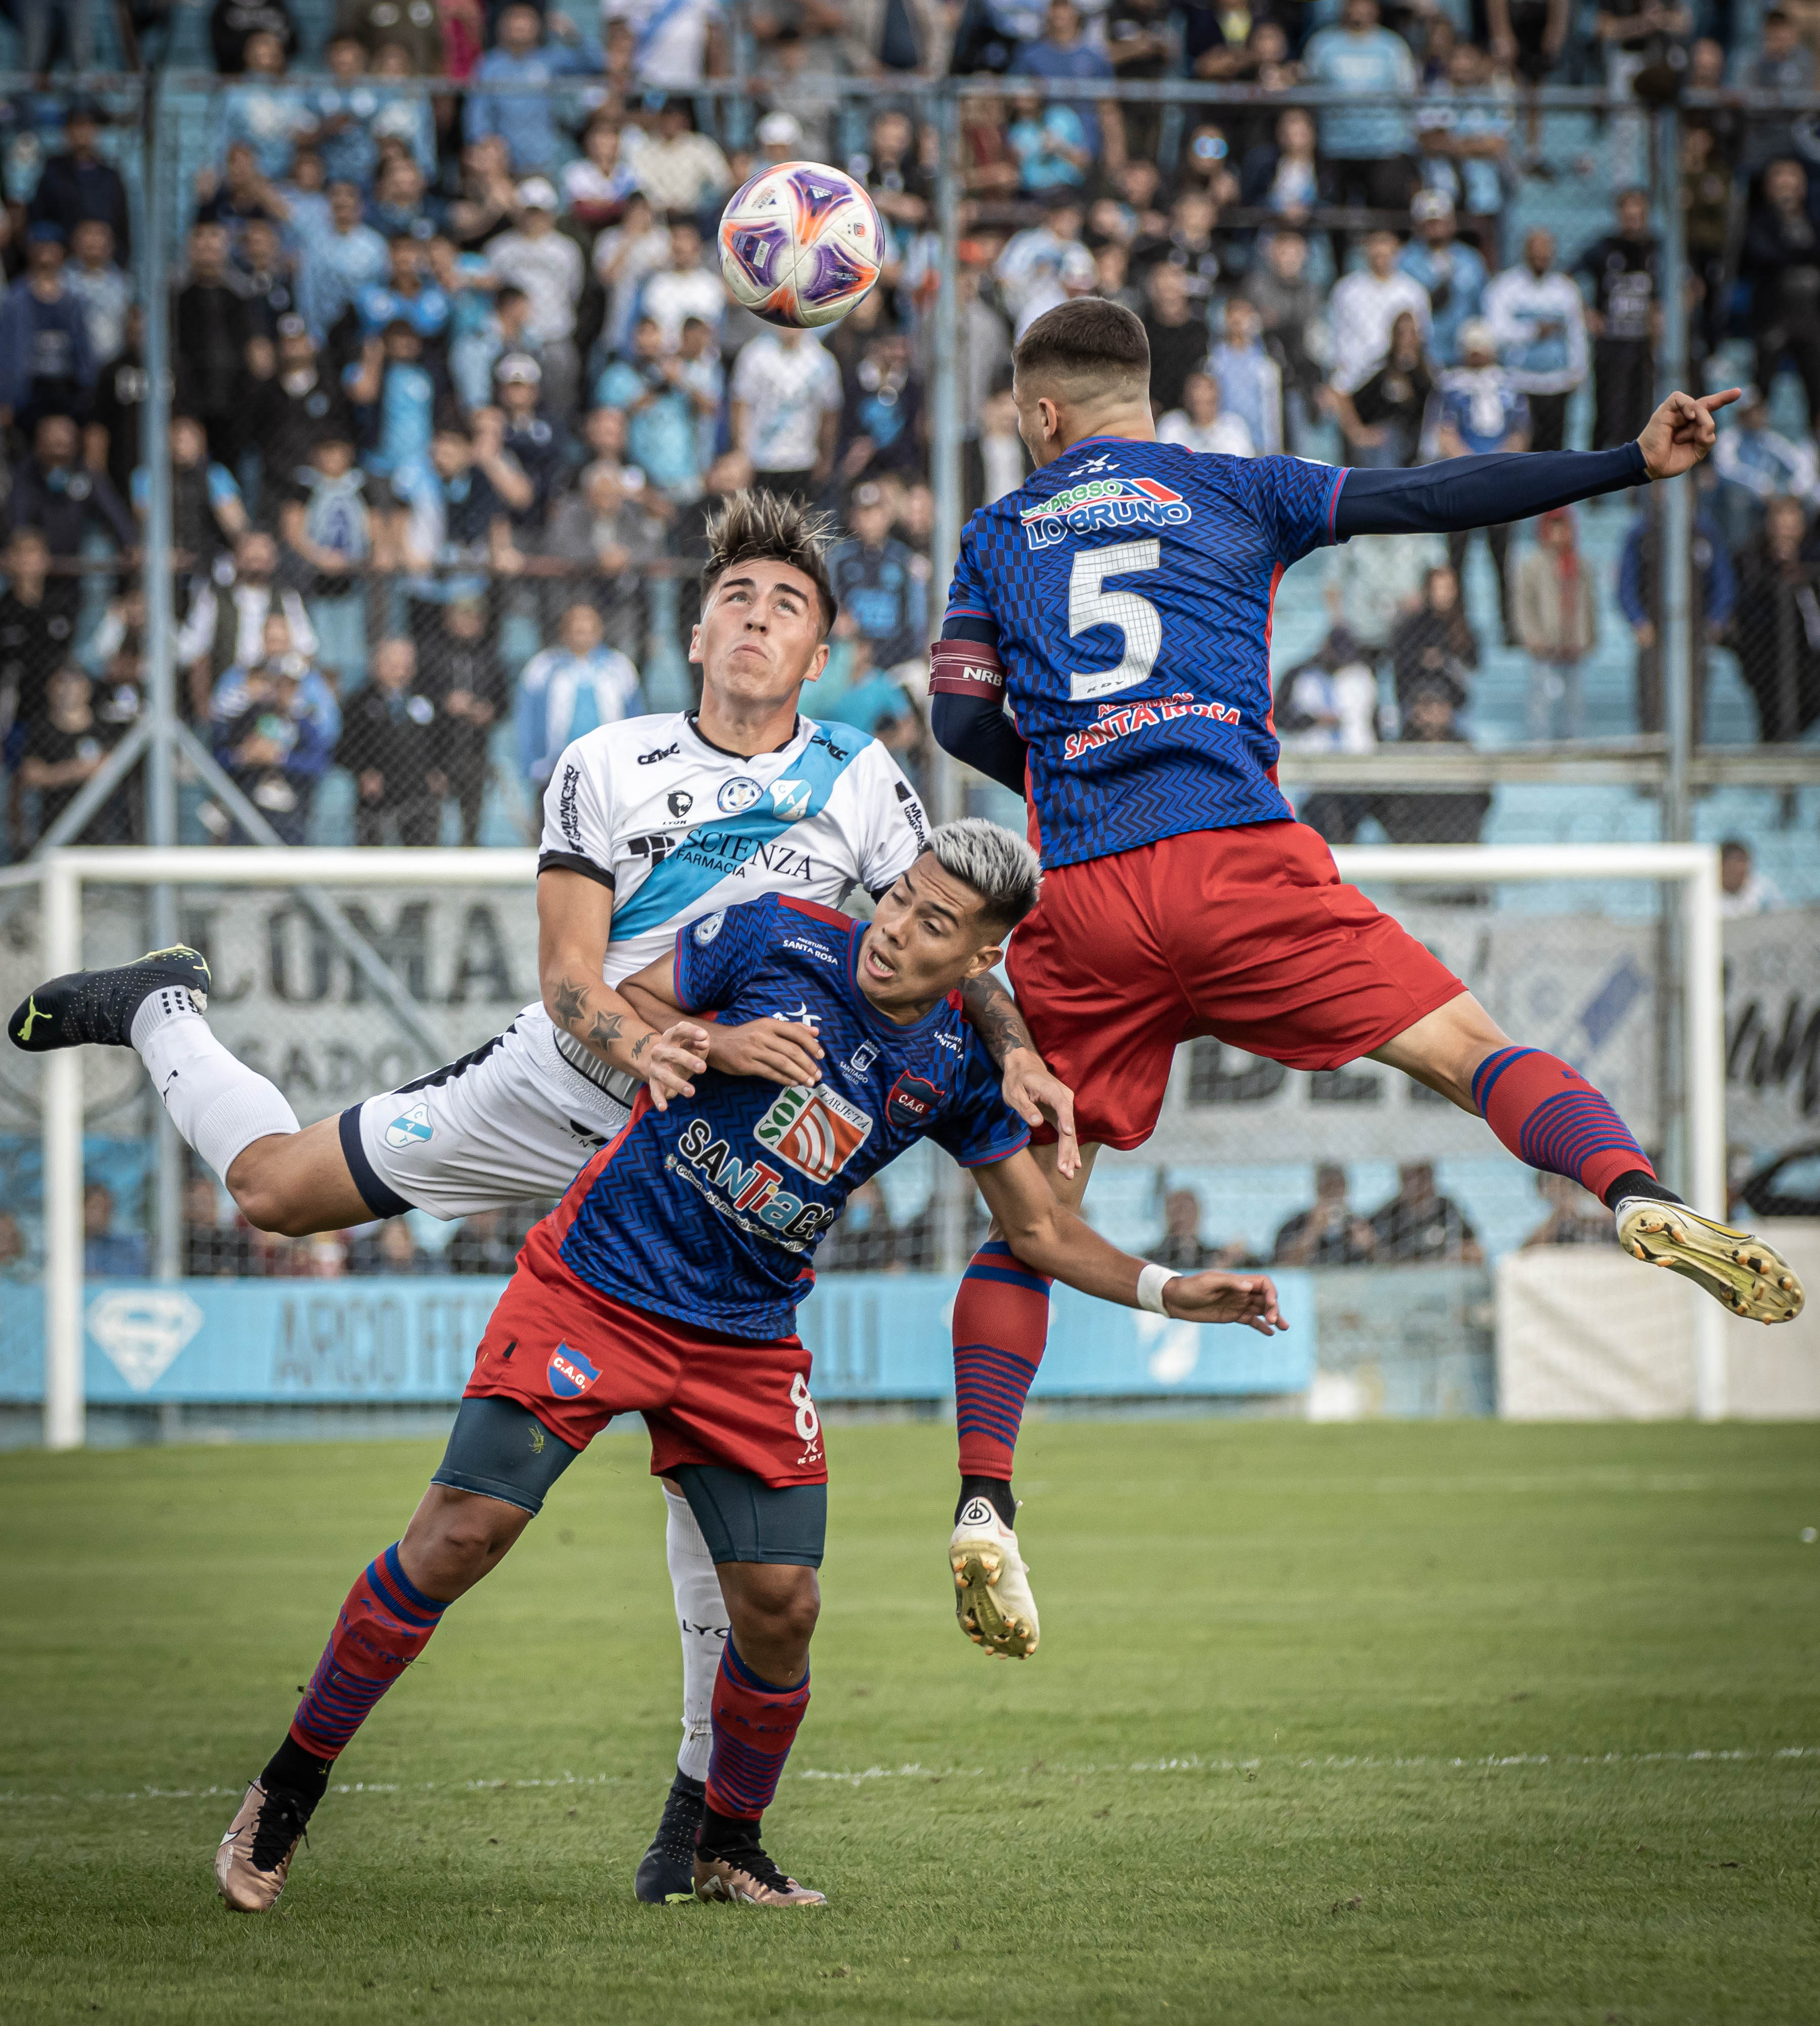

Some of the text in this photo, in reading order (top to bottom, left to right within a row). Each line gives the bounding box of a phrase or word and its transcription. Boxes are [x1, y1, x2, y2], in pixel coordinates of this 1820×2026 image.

[1068, 464, 1120, 477] KDY
[1026, 500, 1192, 550] LO BRUNO
[1068, 538, 1162, 700] 5
[962, 666, 1003, 686] NRB
[1065, 708, 1160, 759] SANTA
[676, 849, 746, 878] FARMACIA
[682, 829, 813, 881] SCIENZA
[783, 939, 838, 965] SANTA ROSA
[797, 937, 829, 952] ABERTURAS
[839, 1061, 868, 1084] SANTIAGO
[758, 1087, 812, 1146] SOL
[819, 1089, 870, 1129] TARJETA
[553, 1357, 586, 1390] C.A.G.
[789, 1372, 819, 1440] 8
[797, 1452, 823, 1465] KDY
[682, 1619, 730, 1639] LYO
